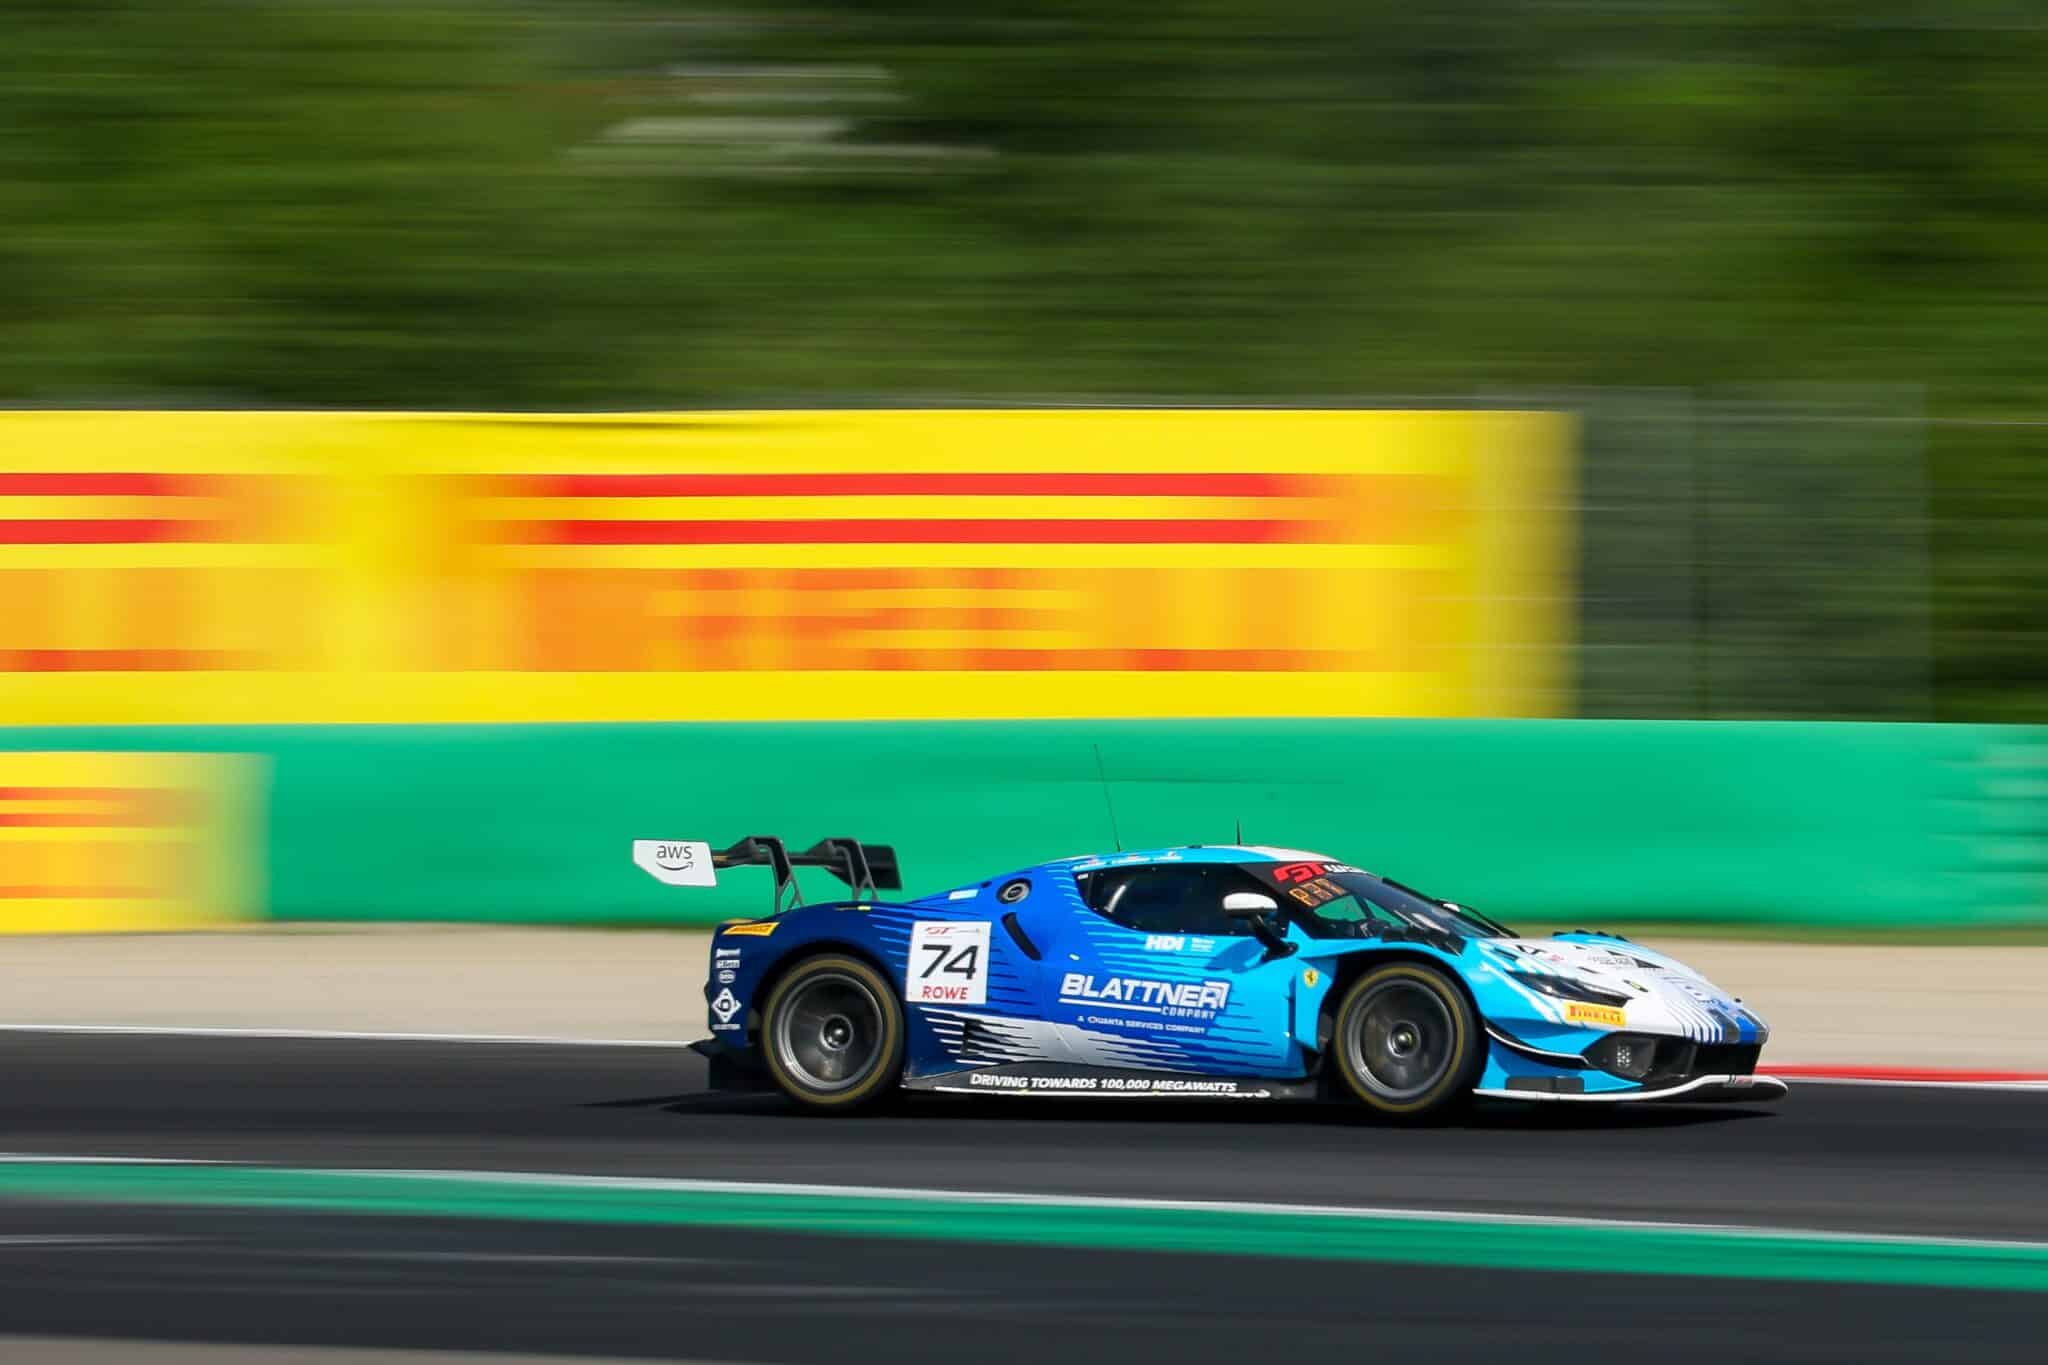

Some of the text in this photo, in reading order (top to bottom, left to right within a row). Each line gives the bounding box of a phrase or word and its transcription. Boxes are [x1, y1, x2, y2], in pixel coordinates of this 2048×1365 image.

[657, 845, 692, 859] aws
[1145, 935, 1184, 952] HDI
[920, 944, 979, 980] 74
[922, 986, 969, 1000] ROWE
[1060, 973, 1230, 1010] BLATTNER
[1161, 1007, 1216, 1020] COMPANY
[1125, 1020, 1164, 1031] SERVICES
[970, 1073, 1238, 1092] DRIVING TOWARDS 100,000 MEGAWATTS
